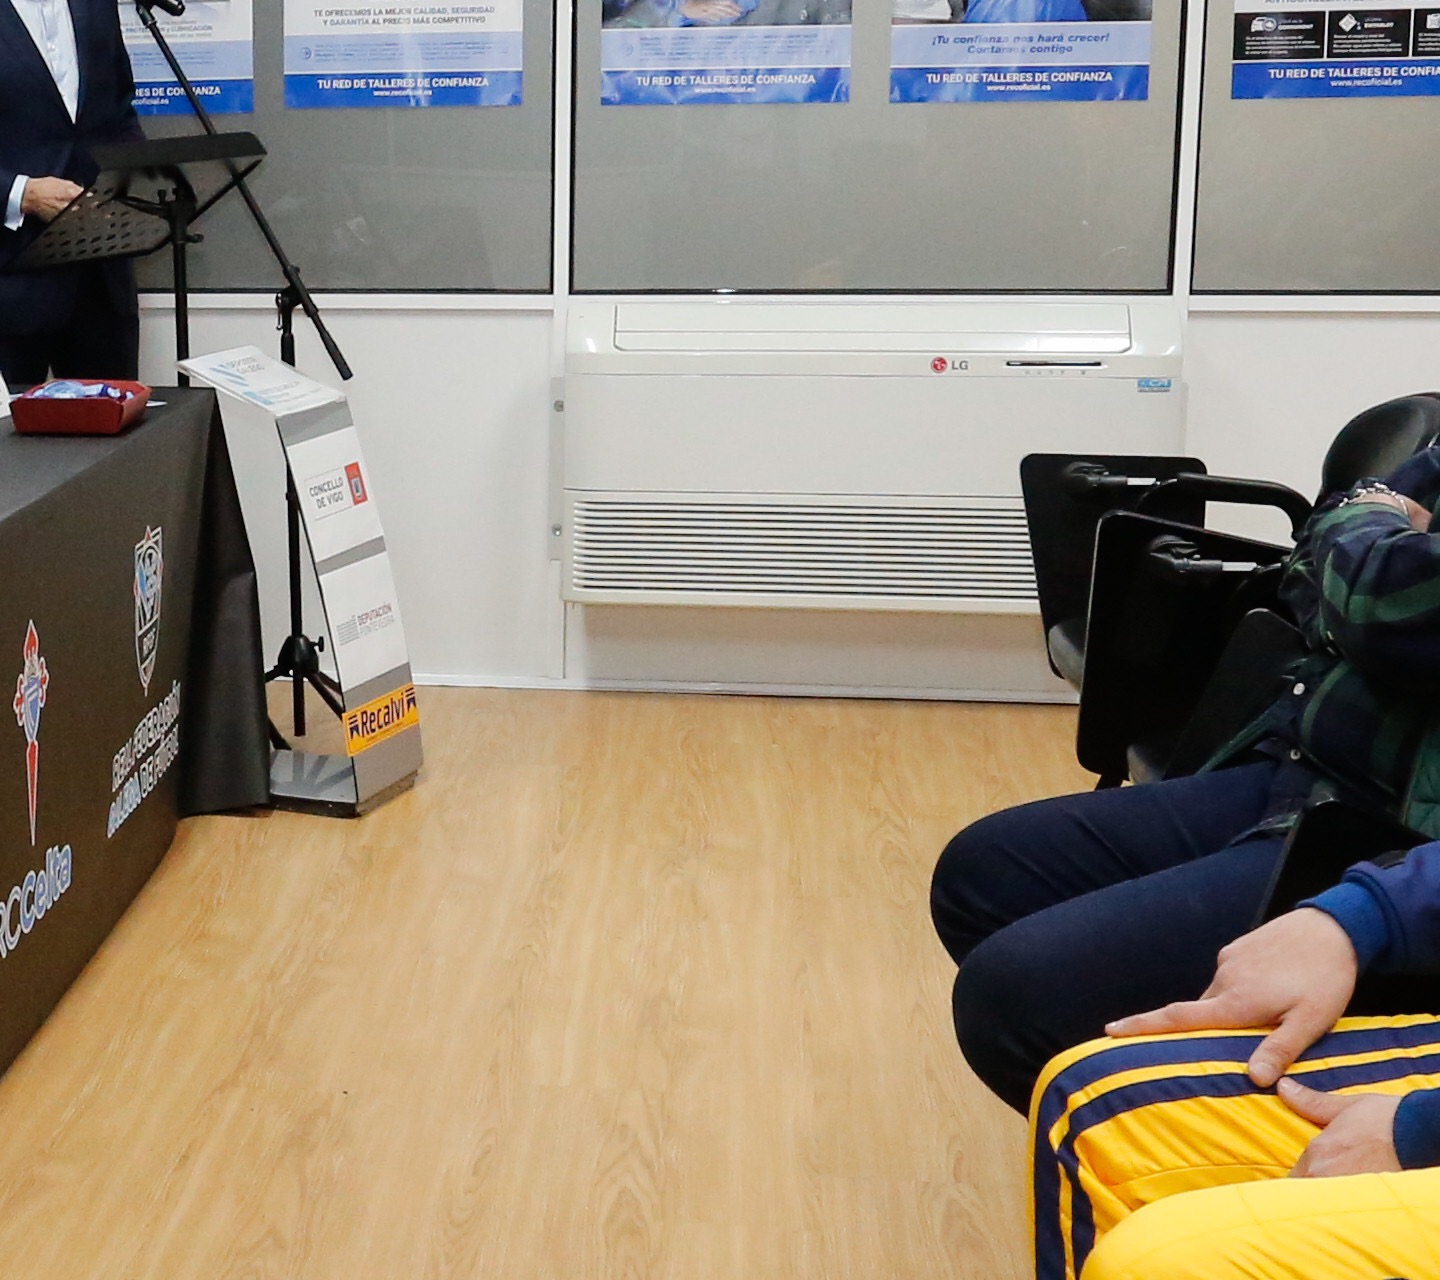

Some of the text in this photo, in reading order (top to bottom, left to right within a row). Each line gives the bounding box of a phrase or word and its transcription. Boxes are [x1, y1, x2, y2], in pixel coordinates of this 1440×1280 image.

[314, 9, 323, 17] TE
[325, 8, 371, 17] OFRECEMOS
[373, 8, 384, 16] LA
[451, 6, 495, 14] SEGURIDAD
[372, 17, 381, 25] AL
[432, 16, 486, 24] COMPETITIVO
[1037, 33, 1065, 43] hará
[1068, 33, 1110, 42] crecer!
[1029, 44, 1073, 55] contigo
[926, 72, 1112, 83] TU RED DE TALLERES DE CONFIANZA
[1269, 69, 1285, 79] TU
[1286, 68, 1308, 78] RED
[1310, 68, 1325, 78] DE
[1327, 67, 1381, 77] TALLERES
[1383, 67, 1398, 76] DE
[317, 78, 489, 89] TU RED DE TALLERES DE CONFIANZA
[636, 74, 816, 86] TU RED DE TALLERES DE CONFIANZA
[1330, 78, 1403, 86] www.recoficial.es
[151, 88, 165, 97] DE
[951, 359, 969, 370] LG
[309, 476, 344, 498] CONCELLO
[317, 492, 344, 510] DE VIGO
[357, 602, 392, 626] DEPUTACIÓN
[360, 693, 406, 737] Recalvi
